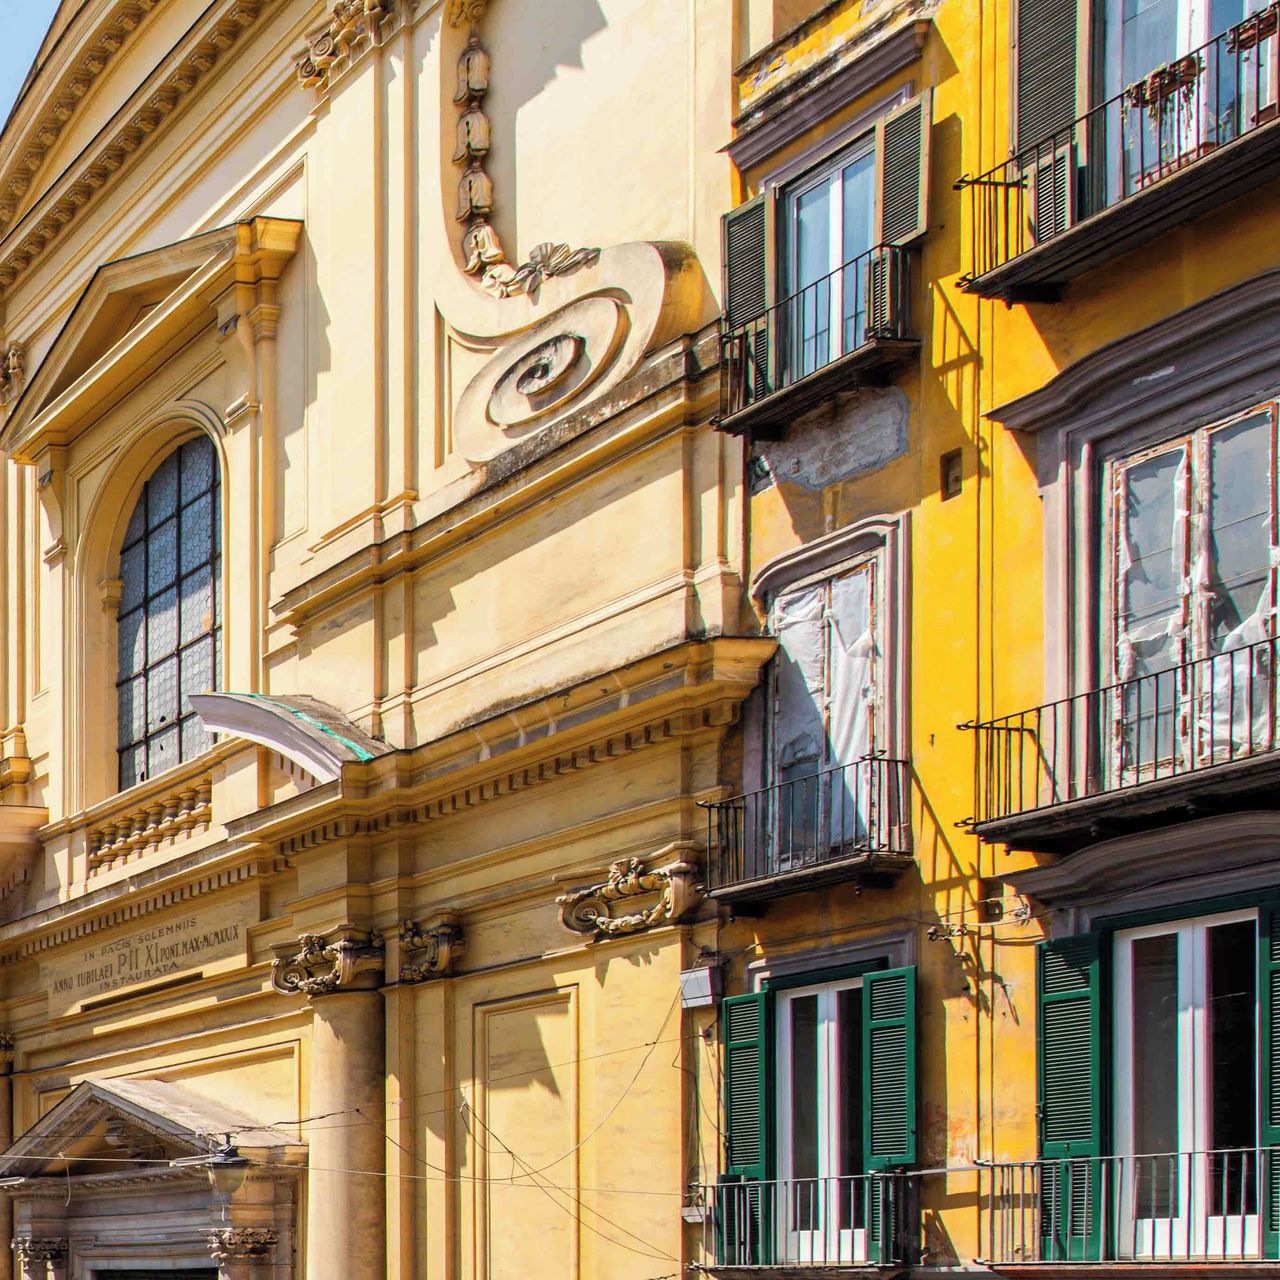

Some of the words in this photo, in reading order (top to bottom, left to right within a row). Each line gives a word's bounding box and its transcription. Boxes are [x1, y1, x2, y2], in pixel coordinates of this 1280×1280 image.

[83, 951, 96, 962] IN
[100, 940, 132, 957] PACIS
[117, 947, 140, 975] PII
[145, 942, 159, 967] XI
[99, 961, 179, 991] INSTAURATA
